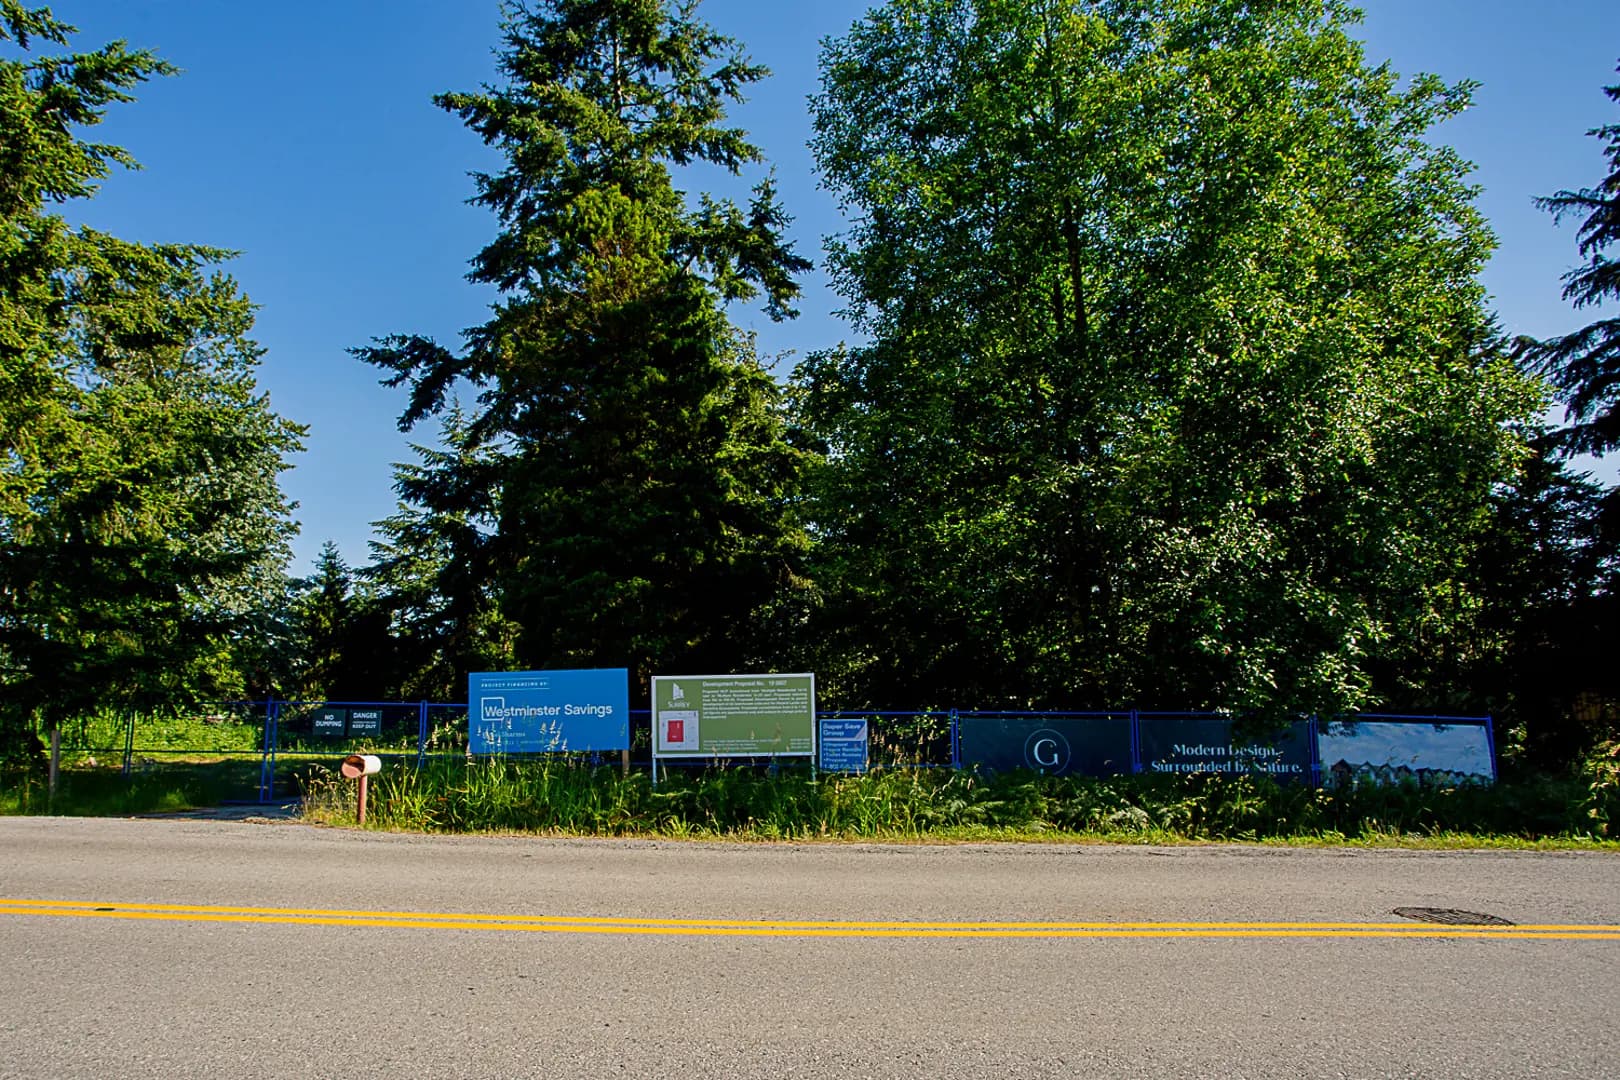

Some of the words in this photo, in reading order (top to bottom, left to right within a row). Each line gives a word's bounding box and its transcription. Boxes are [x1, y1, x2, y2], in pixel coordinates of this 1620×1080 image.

[484, 705, 561, 717] Westminster
[564, 703, 613, 717] Savings
[1033, 738, 1059, 766] G
[1172, 744, 1225, 756] Modern
[1151, 760, 1231, 773] Surrounded
